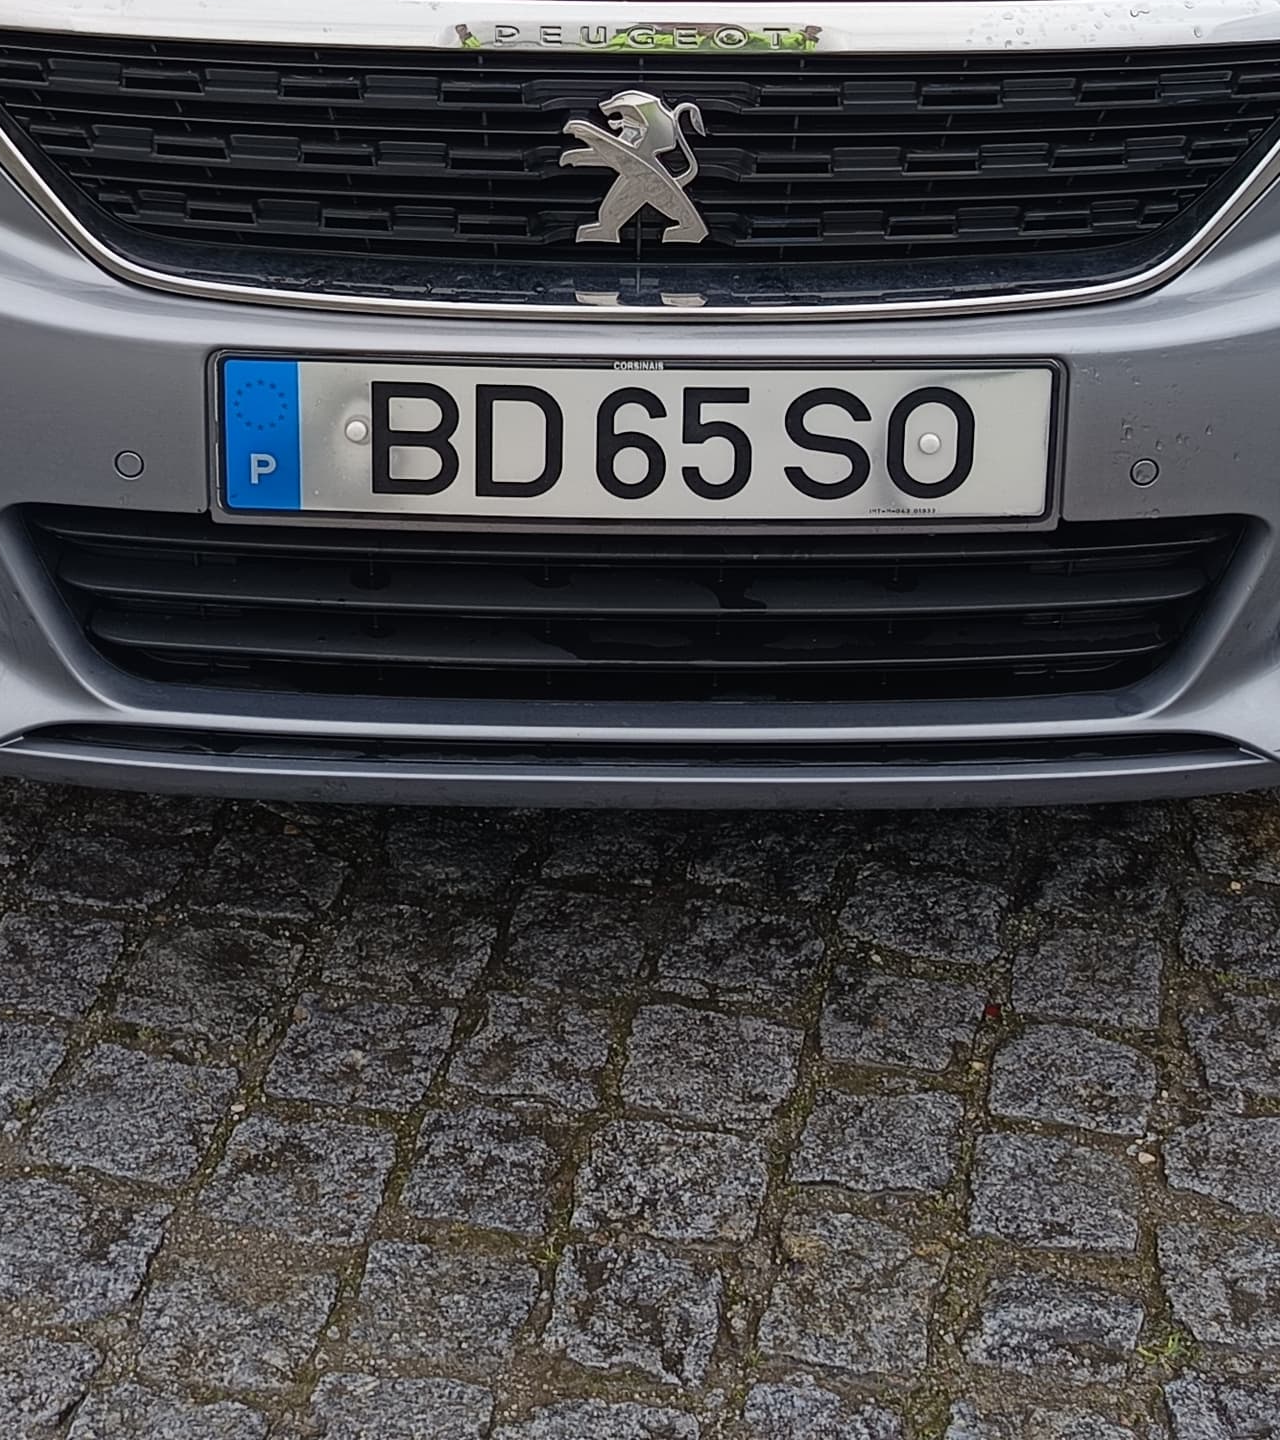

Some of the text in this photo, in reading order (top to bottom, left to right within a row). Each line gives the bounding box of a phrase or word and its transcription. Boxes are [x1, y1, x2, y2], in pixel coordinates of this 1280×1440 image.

[494, 24, 790, 50] PEUGEOT
[371, 381, 564, 498] BD
[596, 386, 752, 500] 65
[250, 453, 277, 485] P
